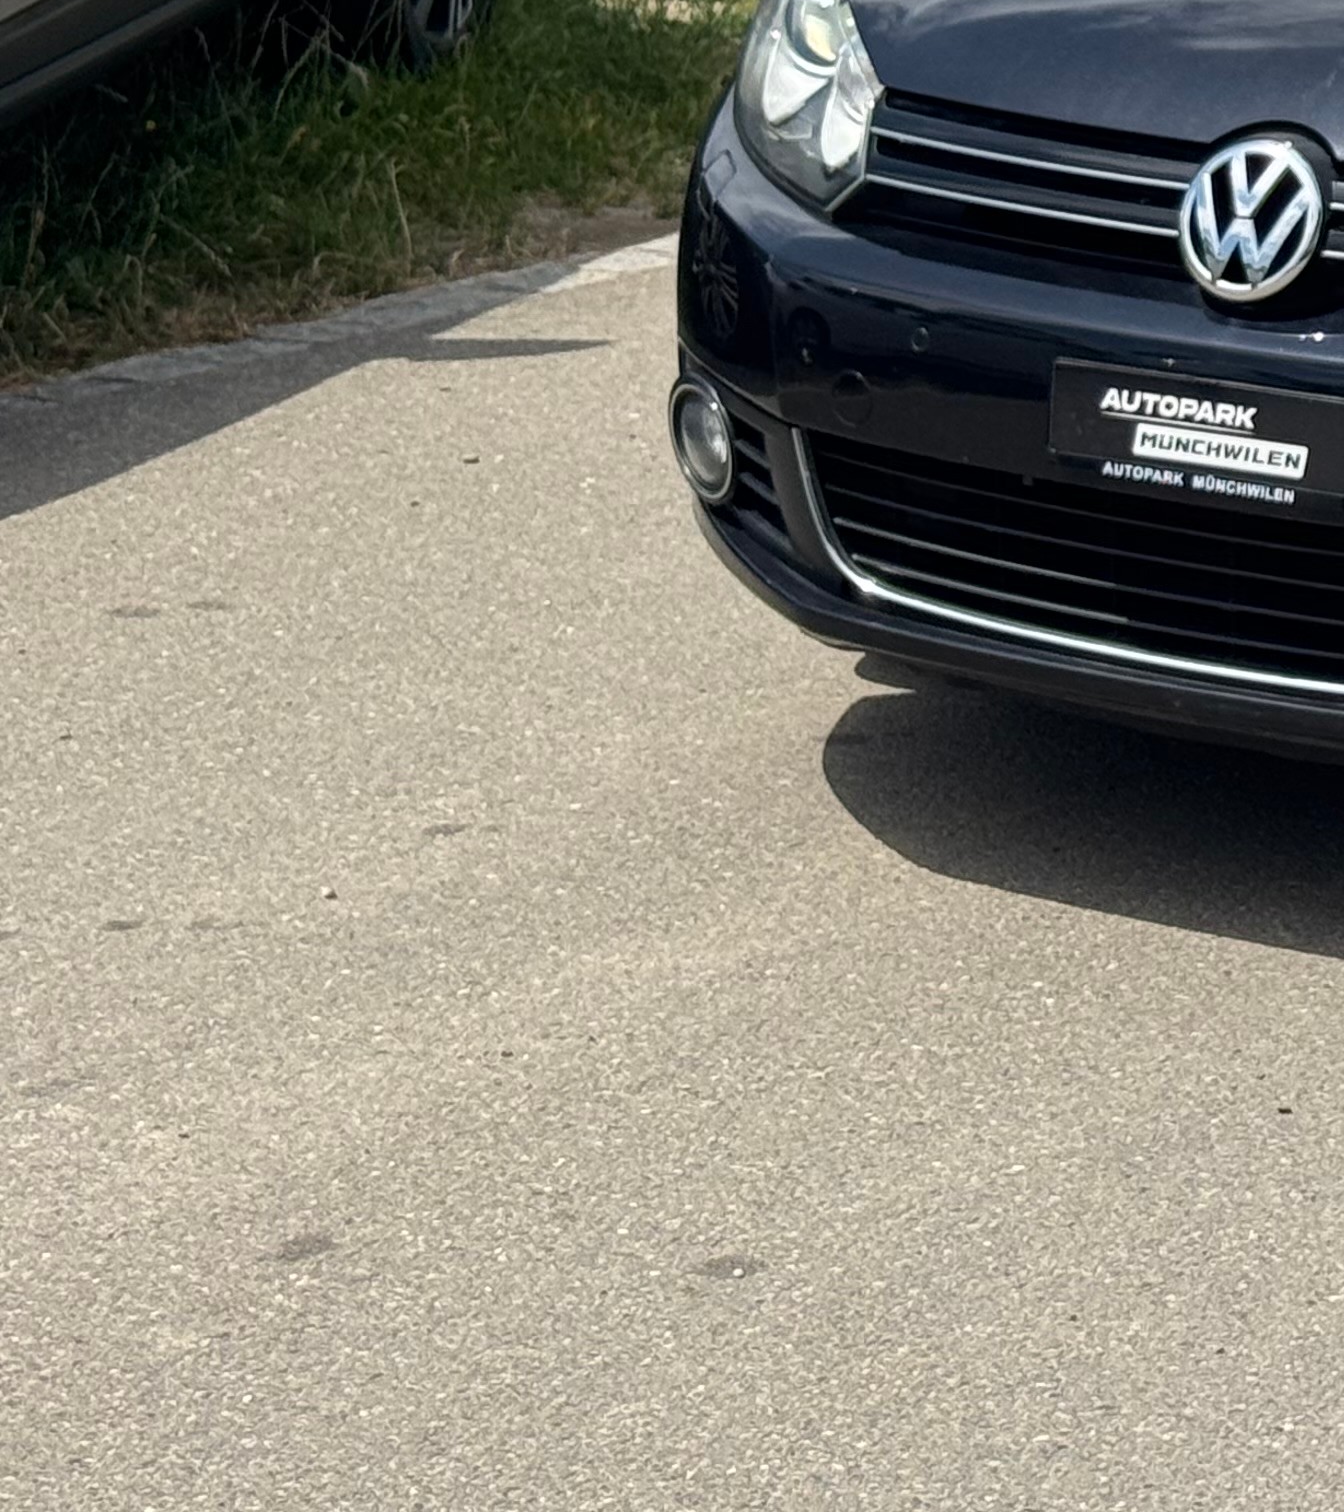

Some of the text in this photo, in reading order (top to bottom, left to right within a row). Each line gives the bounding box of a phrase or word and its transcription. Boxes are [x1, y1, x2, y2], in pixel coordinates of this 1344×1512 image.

[1195, 150, 1311, 285] VW
[1100, 388, 1257, 429] AUTOPARK
[1139, 431, 1301, 470] MÜNCHWILEN
[1102, 461, 1295, 504] AUTOPARK MÜNCHWILEN
